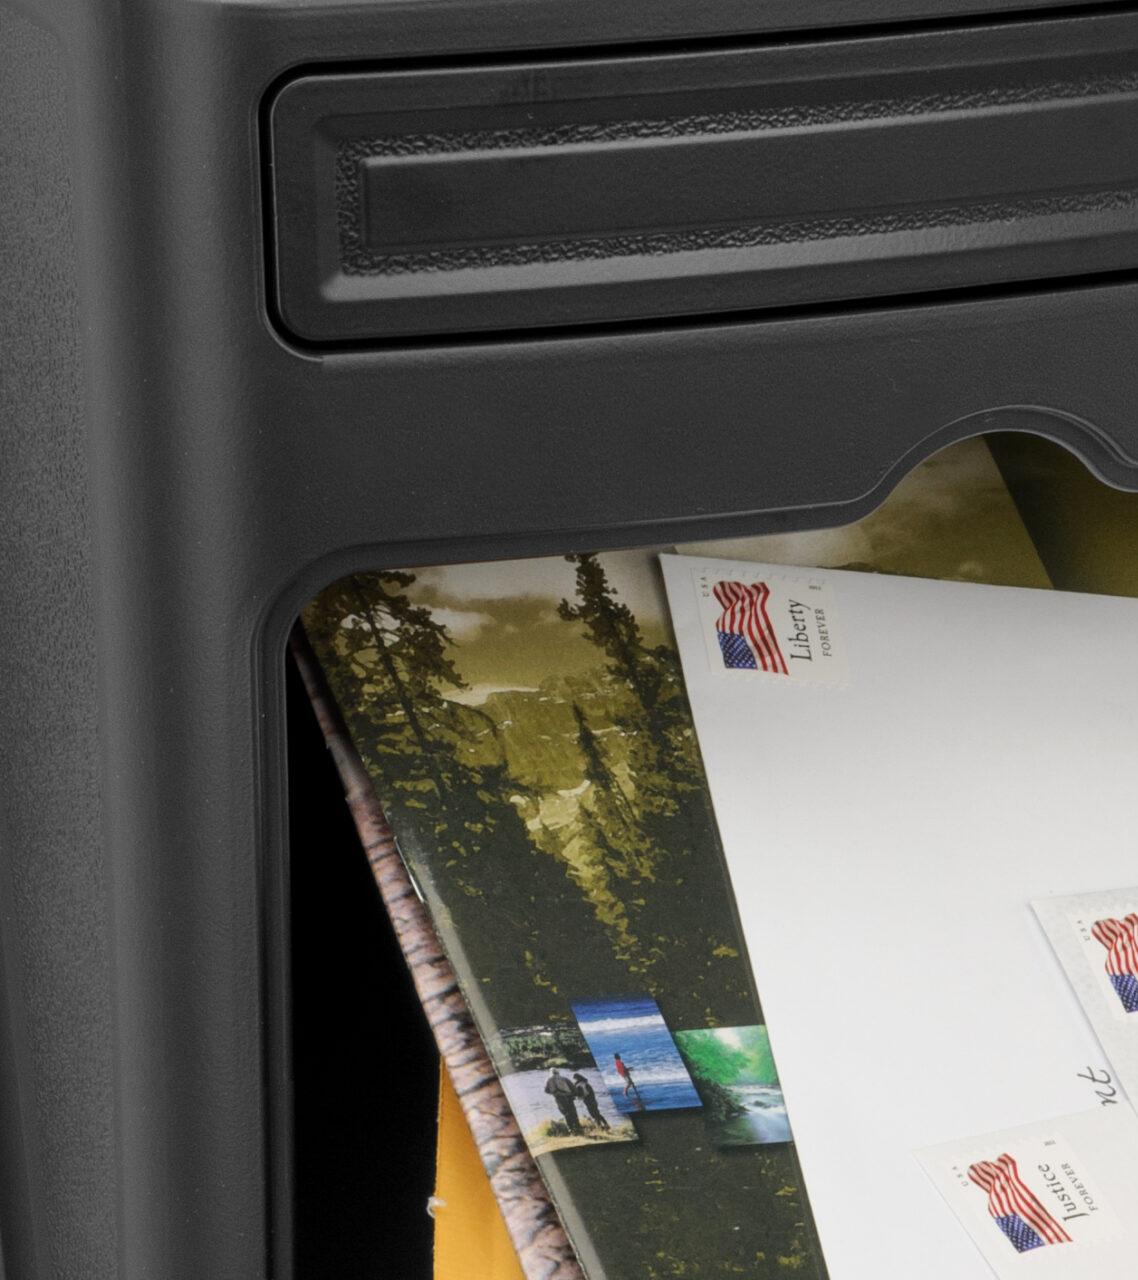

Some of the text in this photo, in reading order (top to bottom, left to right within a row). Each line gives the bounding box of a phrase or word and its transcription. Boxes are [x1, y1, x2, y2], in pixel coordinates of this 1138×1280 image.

[788, 599, 813, 661] Liberty
[815, 608, 832, 657] FOREVER
[1038, 1163, 1090, 1221] Justice
[1061, 1162, 1098, 1212] FOREVER
